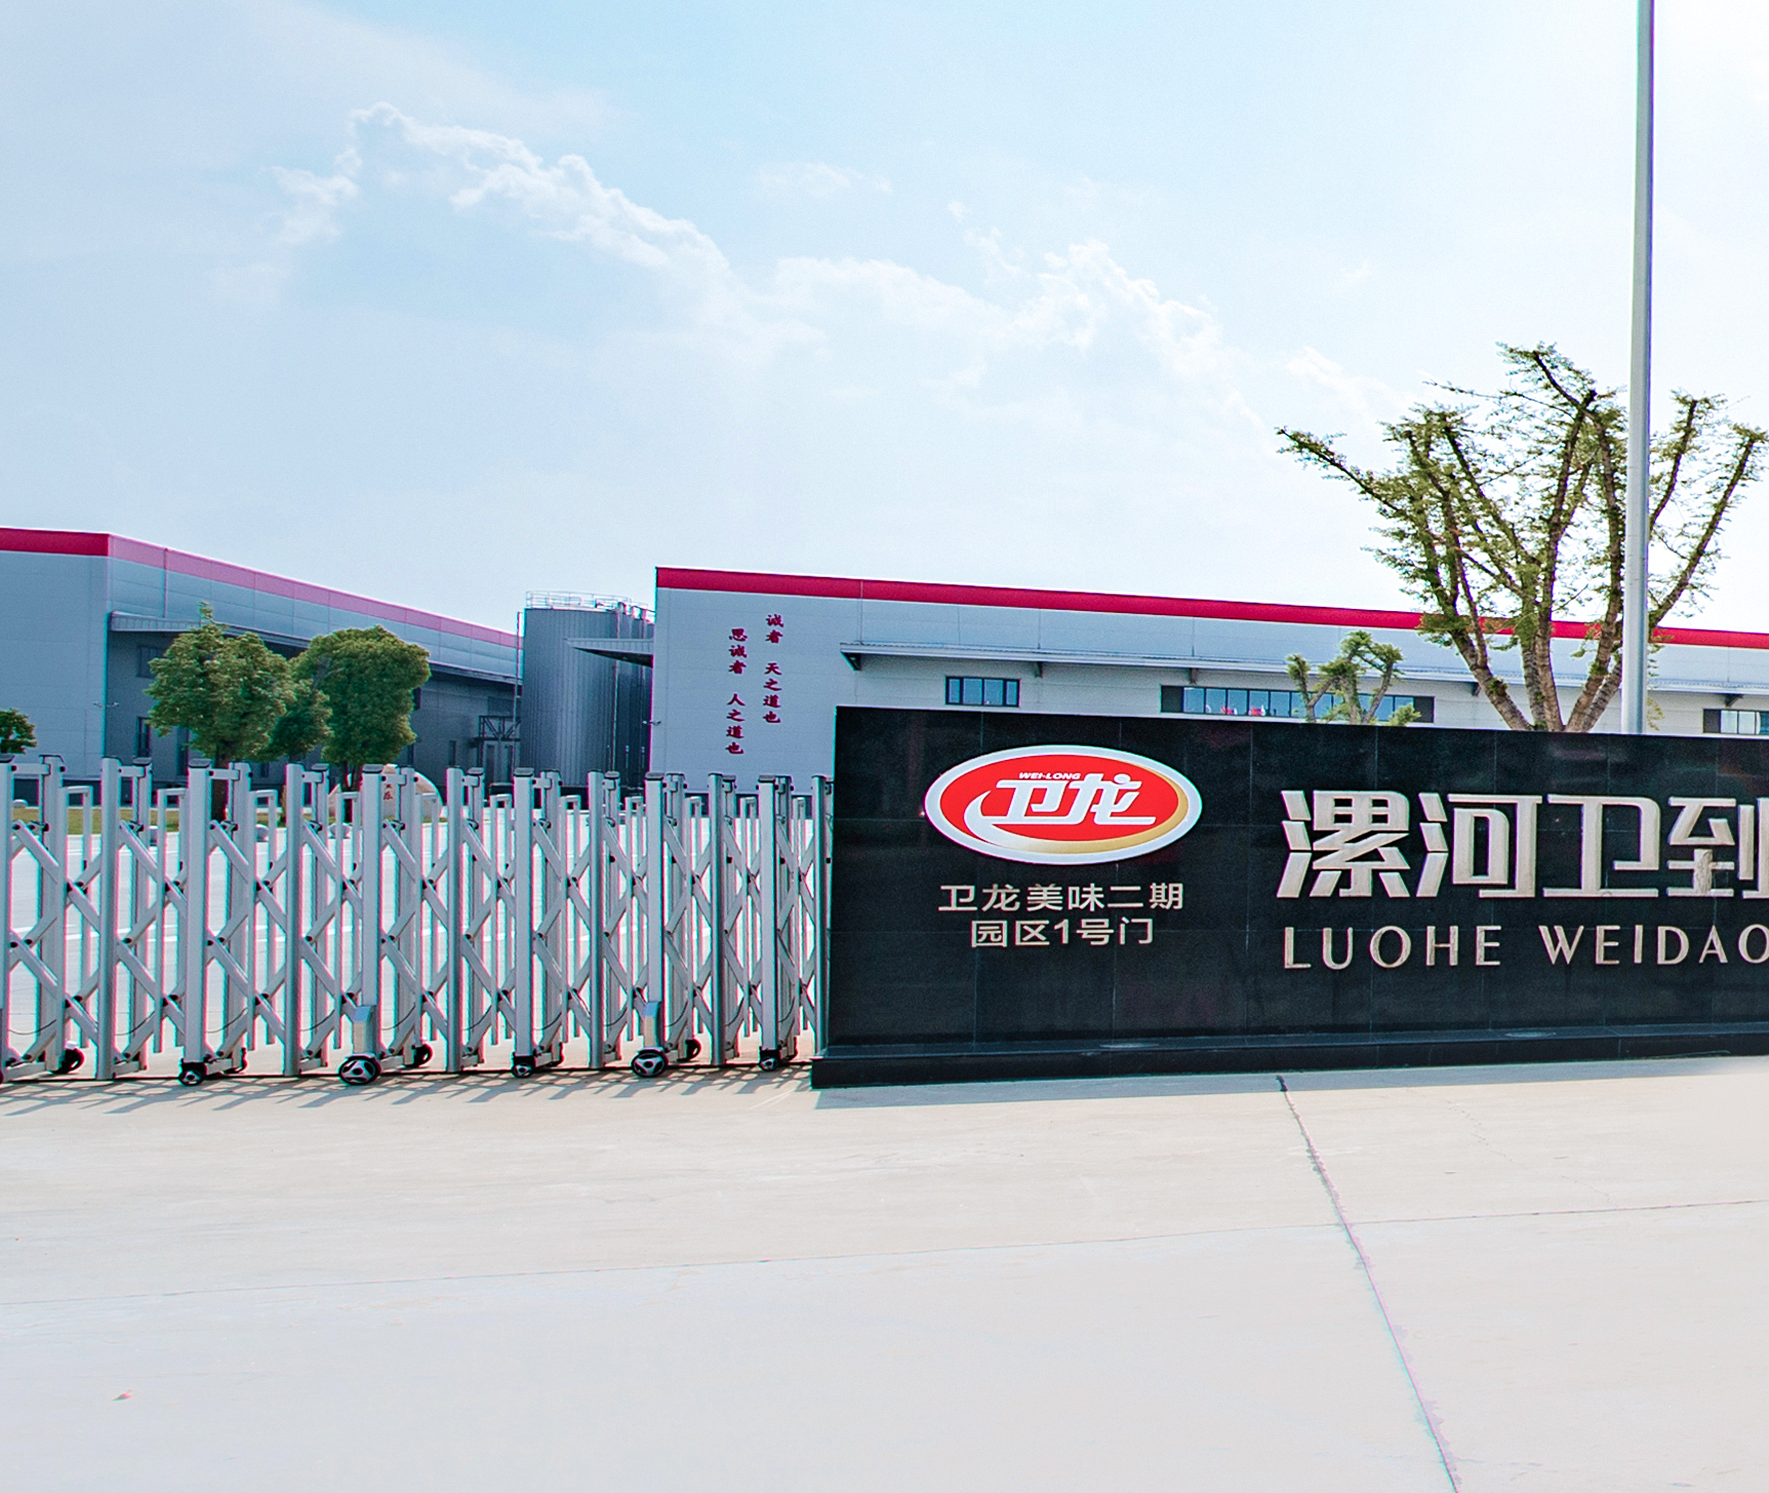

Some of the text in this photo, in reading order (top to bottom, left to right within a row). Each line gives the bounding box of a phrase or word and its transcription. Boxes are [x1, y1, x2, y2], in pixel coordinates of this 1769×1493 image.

[762, 661, 783, 724] 天之道也
[725, 692, 746, 755] 人之道也
[1018, 771, 1082, 781] WEI-LONG
[982, 772, 1157, 826] 卫龙
[937, 881, 1185, 912] 卫龙美味二期
[970, 916, 1154, 948] 园区1号门
[1283, 924, 1502, 969] LUOHE
